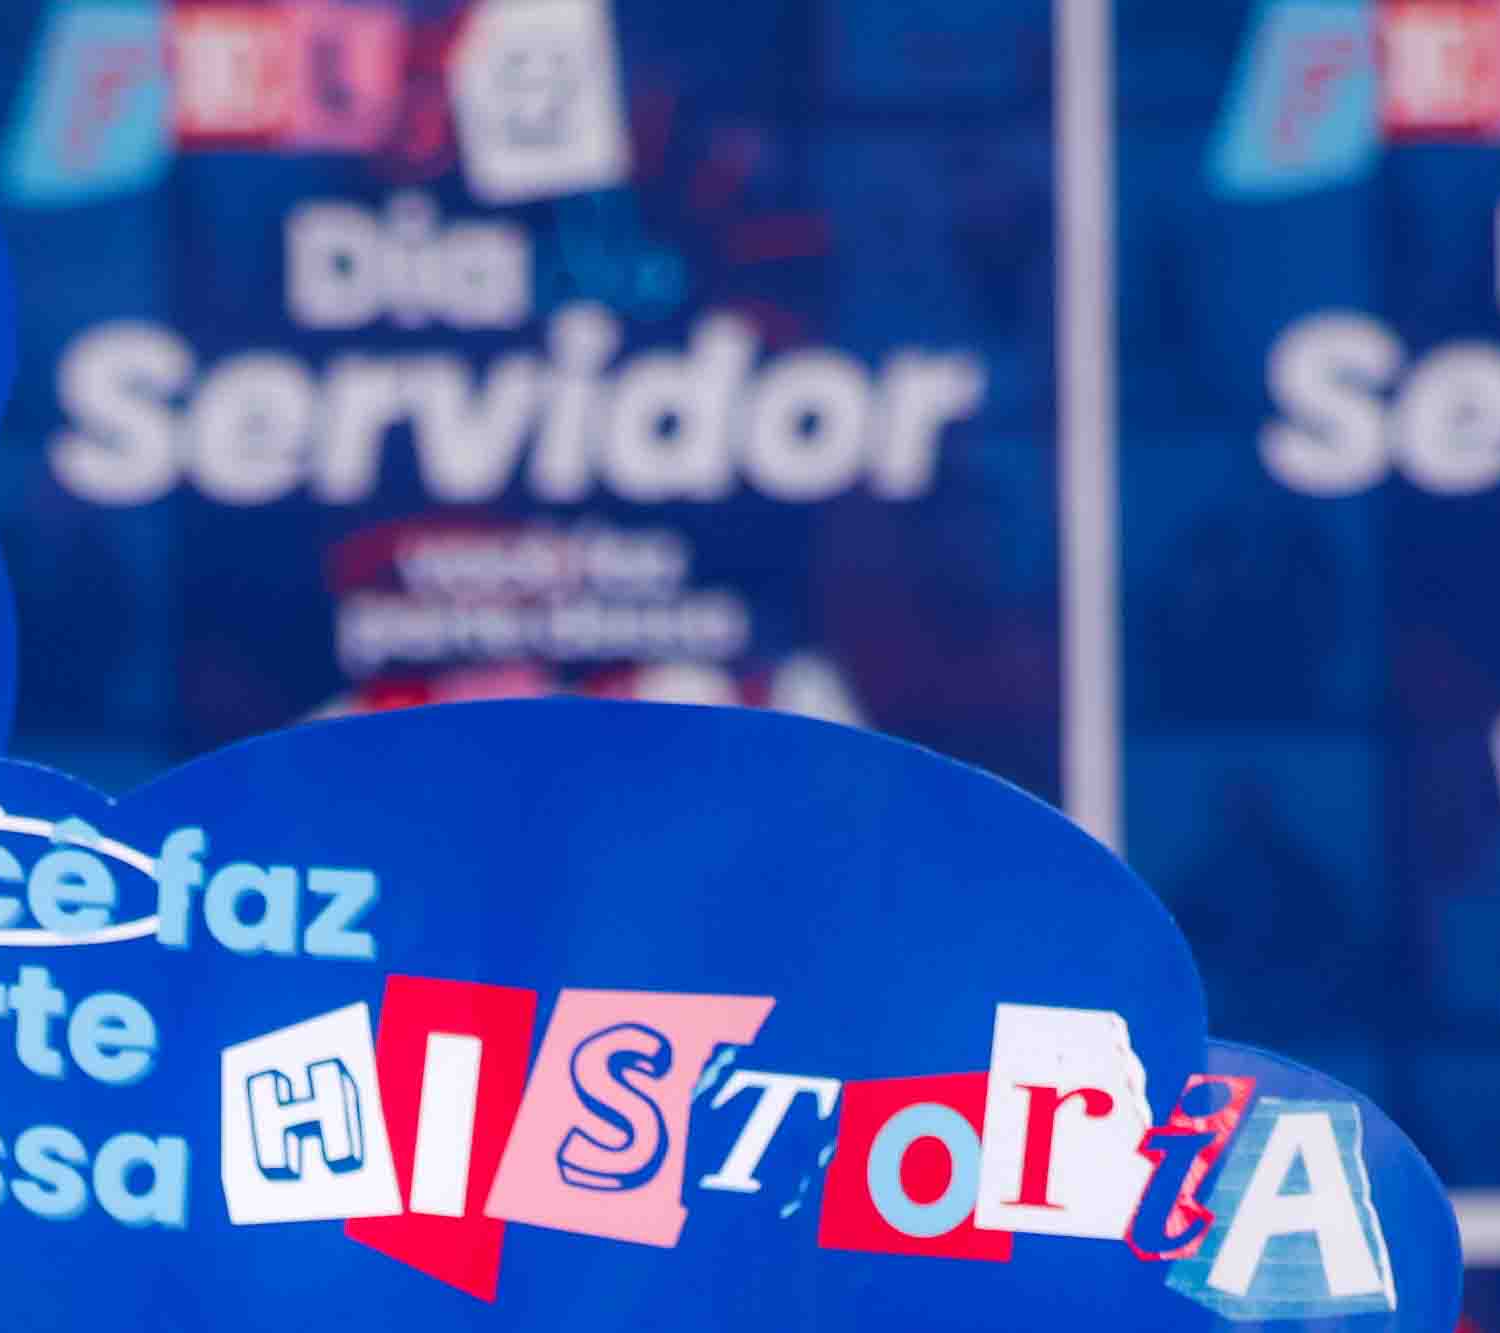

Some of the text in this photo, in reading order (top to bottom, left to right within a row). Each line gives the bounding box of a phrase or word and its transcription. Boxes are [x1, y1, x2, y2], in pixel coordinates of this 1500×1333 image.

[284, 193, 535, 330] Dia
[50, 305, 984, 504] Servidor
[155, 826, 380, 960] faz
